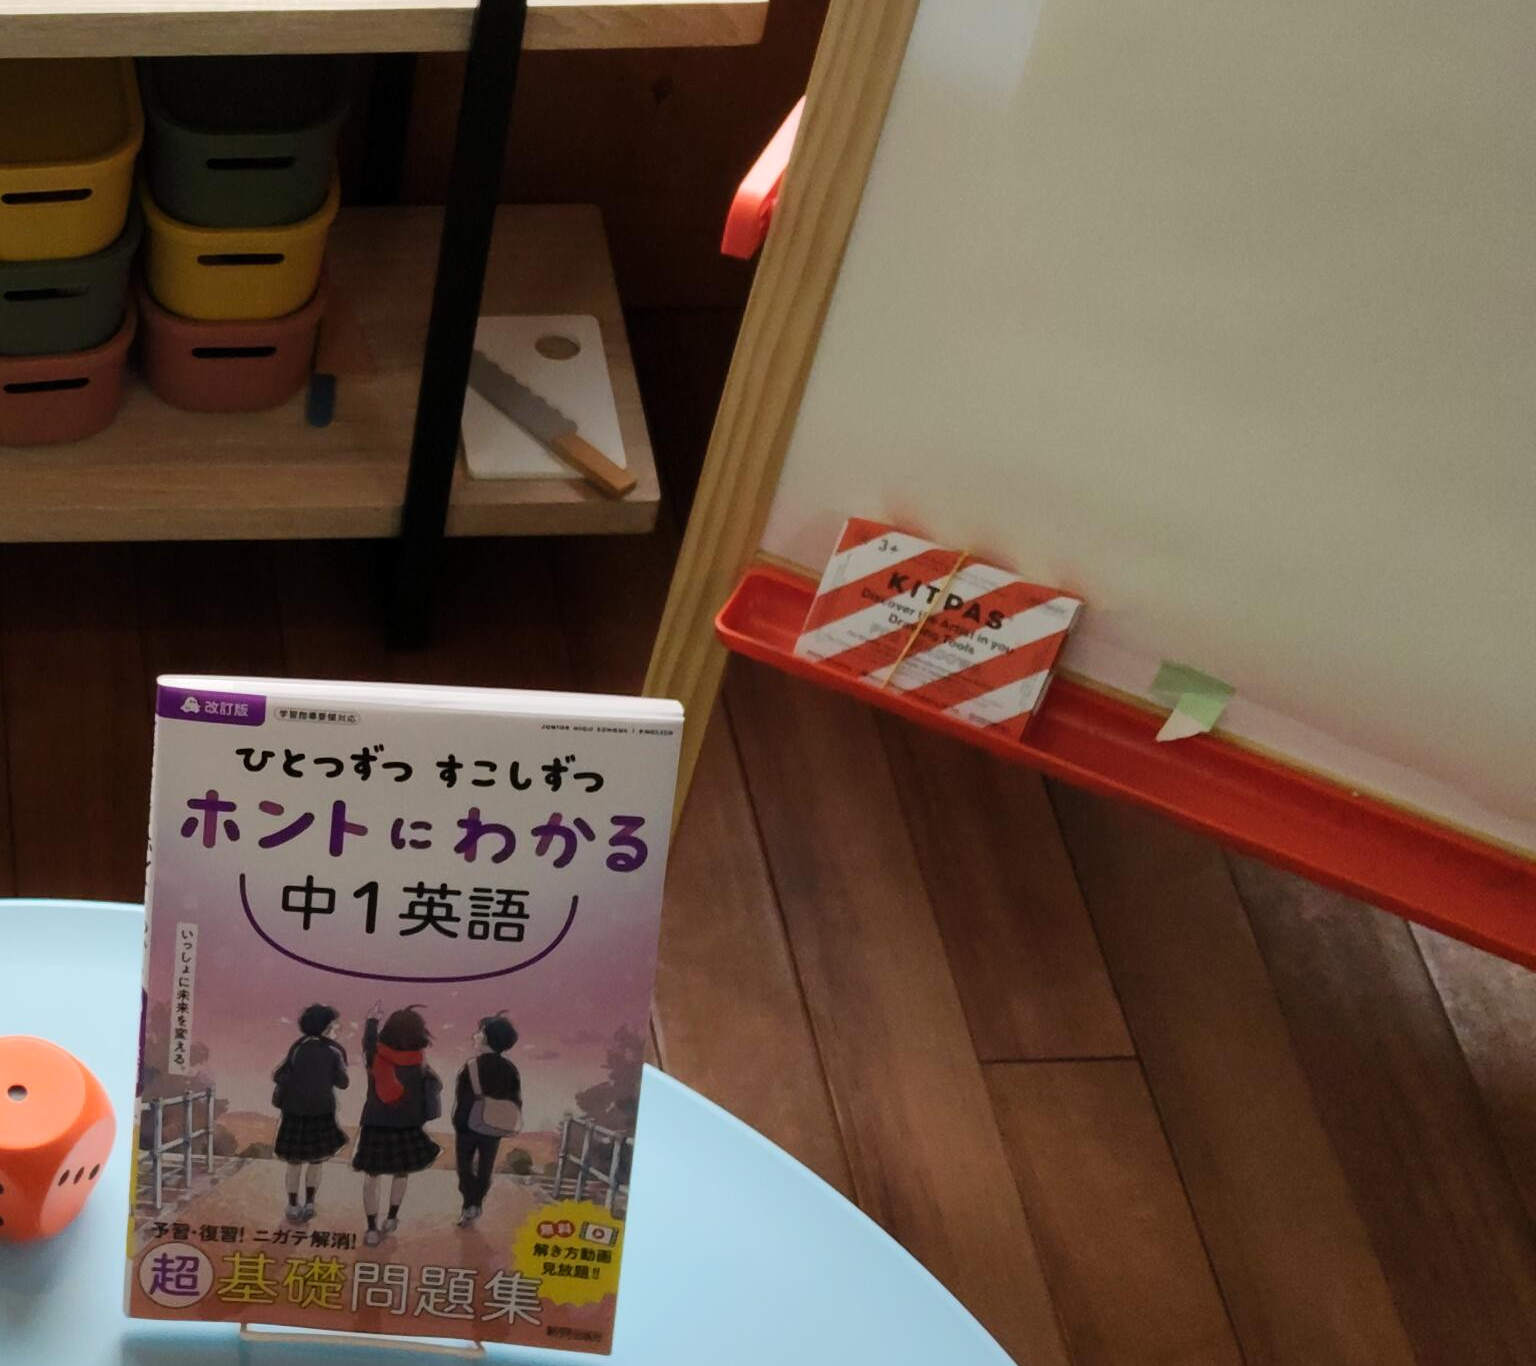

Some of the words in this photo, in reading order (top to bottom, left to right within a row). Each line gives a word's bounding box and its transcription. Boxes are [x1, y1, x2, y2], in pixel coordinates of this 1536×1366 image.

[877, 539, 899, 554] 3+
[887, 571, 1008, 631] KITPAS
[942, 635, 975, 656] Tools
[976, 634, 990, 647] in
[203, 700, 250, 718] 改訂版
[235, 742, 414, 783] ひとつずつ
[434, 753, 605, 793] すこしずつ
[179, 788, 650, 873] ホントにわかる
[281, 874, 532, 944] 中1英語
[532, 1242, 612, 1264] 解き方動画
[149, 1251, 202, 1300] 超
[215, 1249, 545, 1328] 基礎問題集
